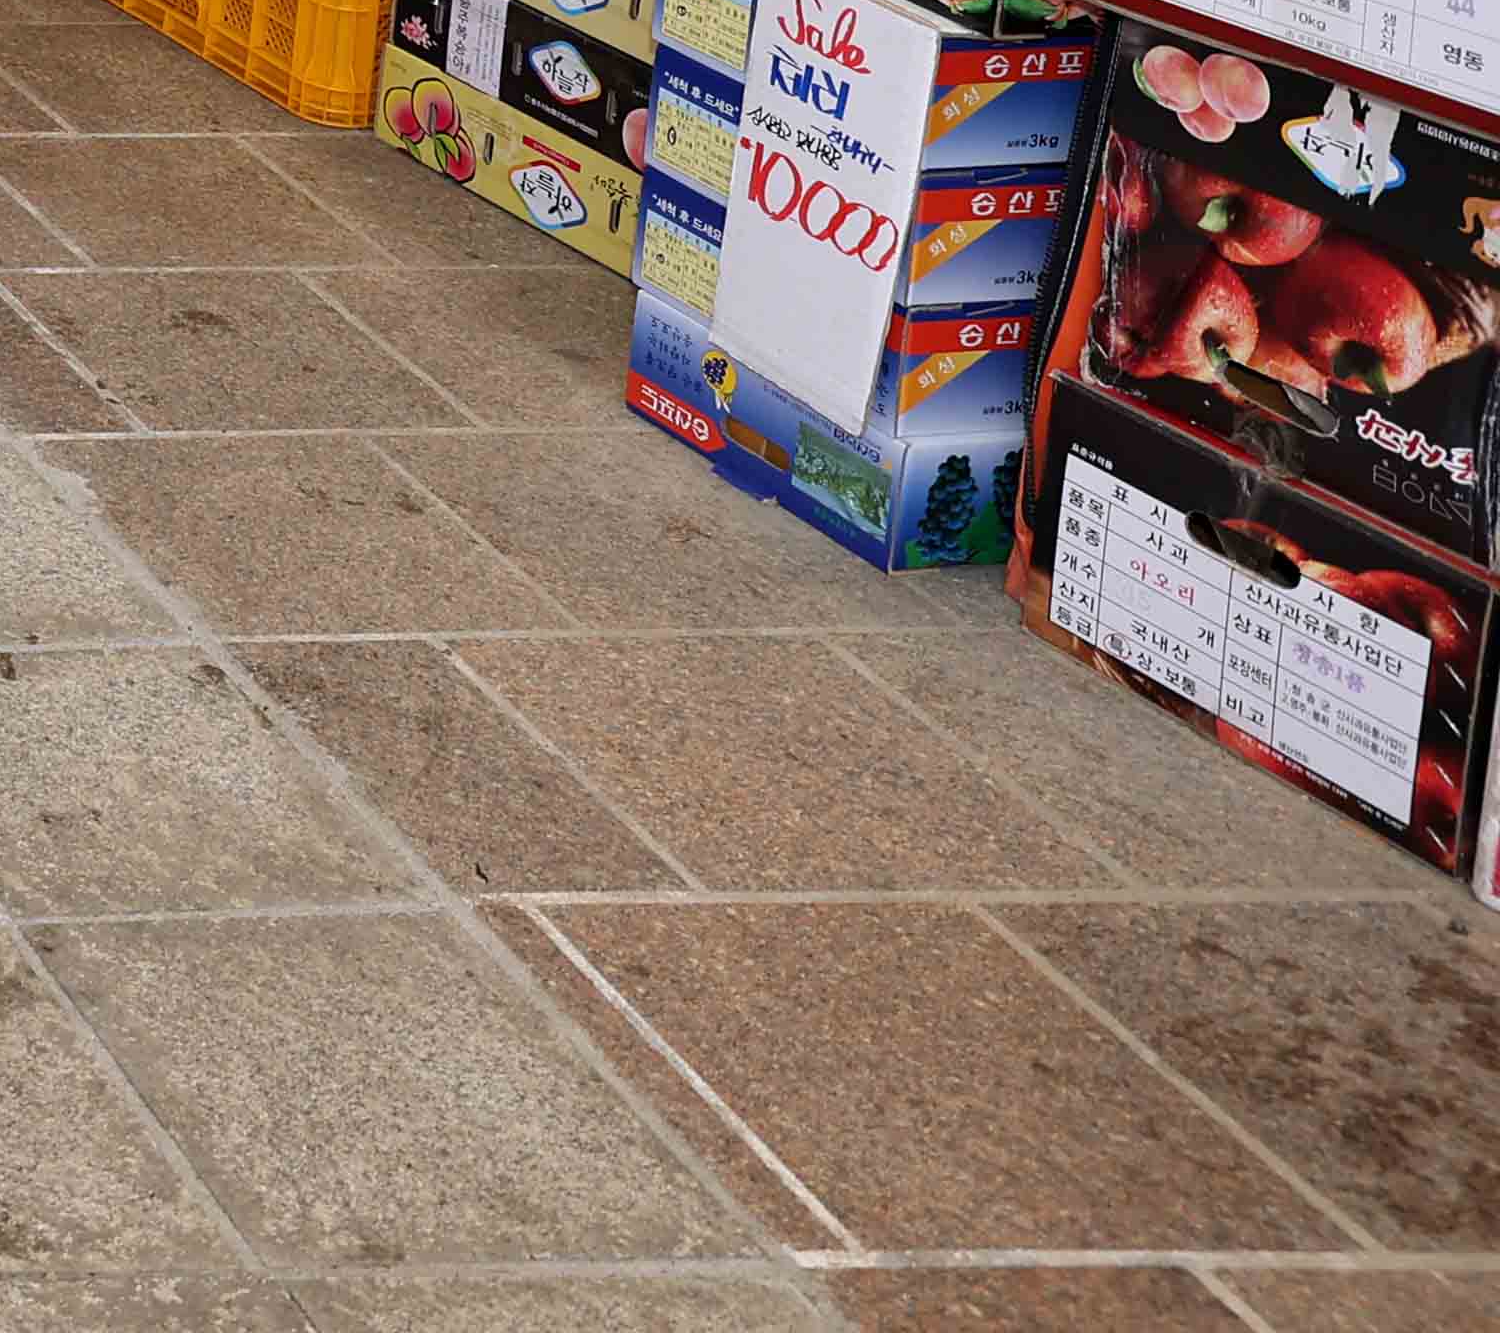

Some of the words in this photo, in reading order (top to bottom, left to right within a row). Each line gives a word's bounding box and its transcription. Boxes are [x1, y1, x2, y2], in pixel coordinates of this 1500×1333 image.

[1290, 8, 1327, 33] 10kg
[540, 49, 592, 97] 하늘작
[983, 49, 1085, 78] 송산포
[1442, 42, 1485, 73] 영동
[941, 86, 980, 123] 화성
[1028, 131, 1060, 151] 3kg
[928, 222, 967, 260] 화성
[958, 319, 1021, 349] 송산
[1067, 488, 1105, 517] 품목
[1147, 532, 1190, 564] 사과
[1064, 515, 1101, 547] 품종
[1130, 555, 1198, 607] 아오리
[1053, 604, 1094, 637] 등급
[1058, 582, 1096, 611] 산지
[1131, 619, 1192, 662] 국내산
[1233, 610, 1276, 647] 상표
[1225, 694, 1268, 728] 비고
